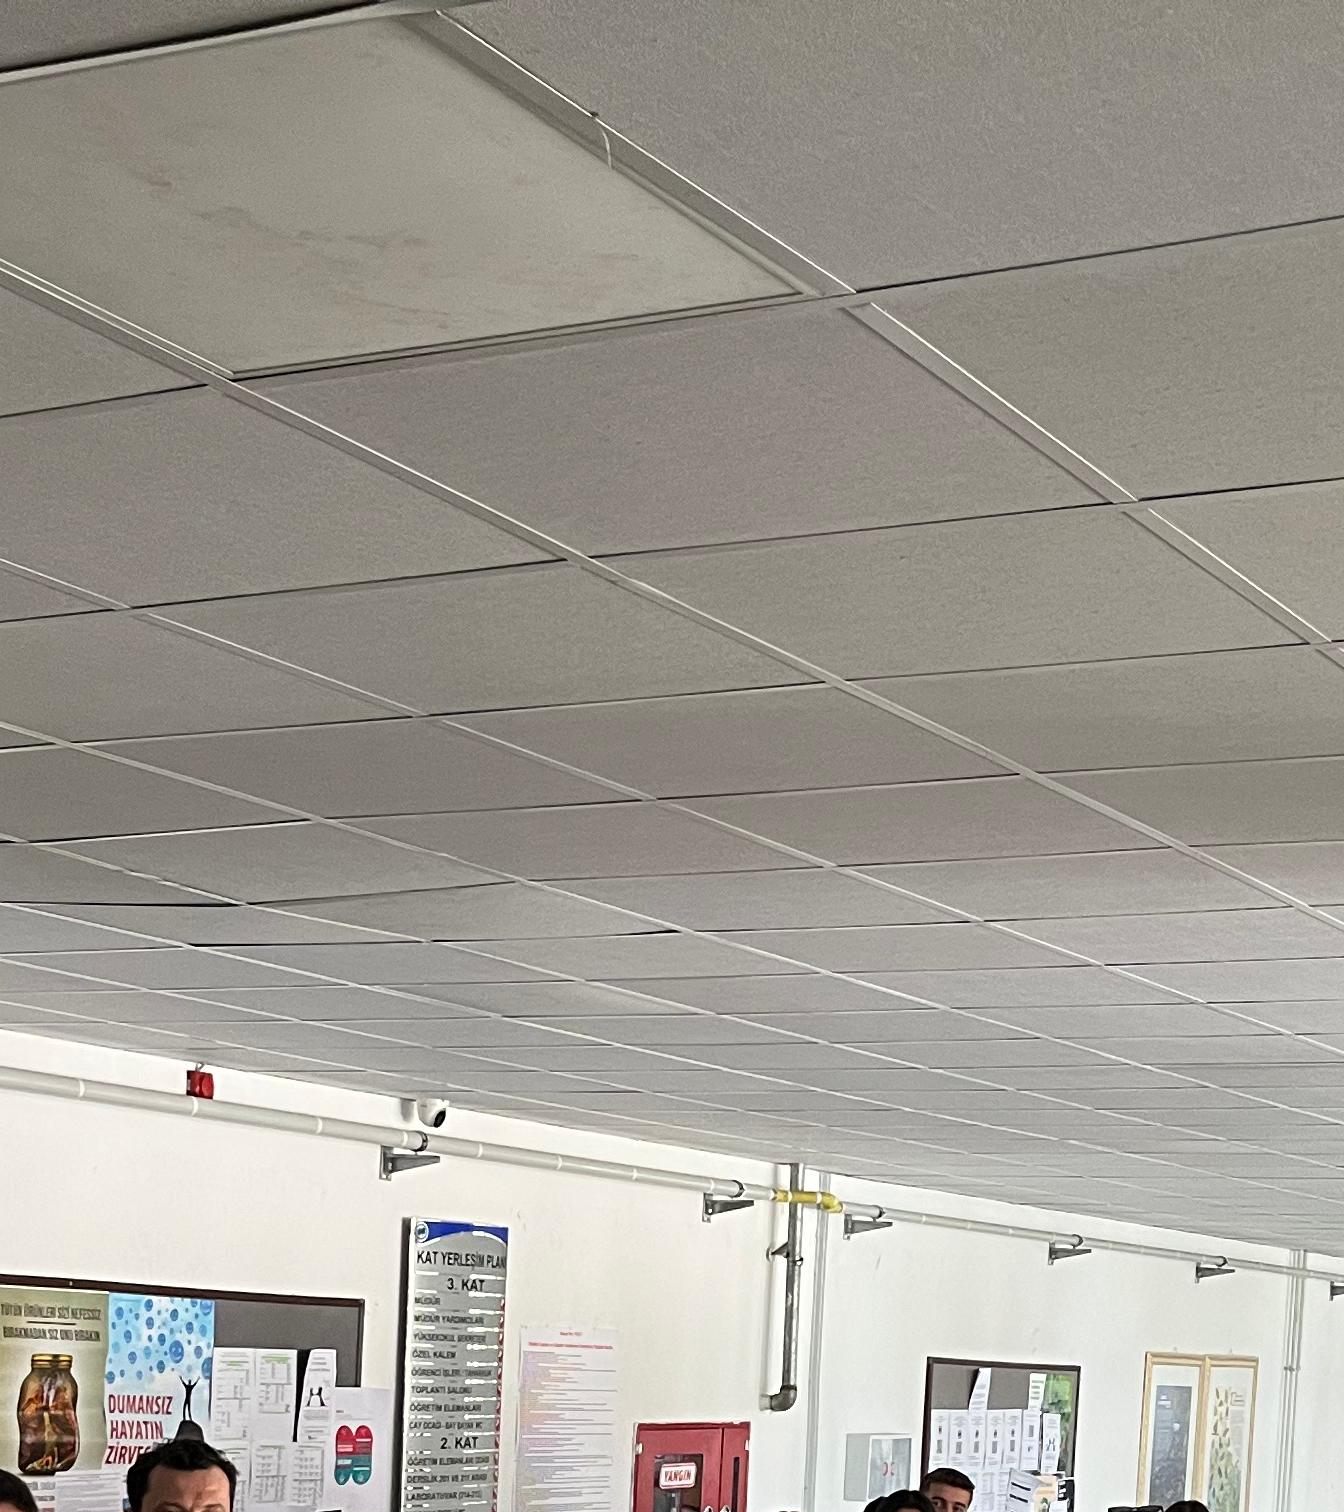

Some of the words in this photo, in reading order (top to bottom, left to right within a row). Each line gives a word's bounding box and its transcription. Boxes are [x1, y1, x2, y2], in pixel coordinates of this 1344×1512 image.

[416, 1251, 438, 1264] KAT
[447, 1277, 457, 1290] 3.
[461, 1279, 485, 1291] KAT
[412, 1349, 431, 1359] ÖZEL
[433, 1351, 456, 1359] KALEM
[108, 1394, 173, 1415] DUMANSIZ
[110, 1420, 164, 1440] HAYATIN
[440, 1437, 451, 1449] 2.
[455, 1436, 478, 1449] KAT
